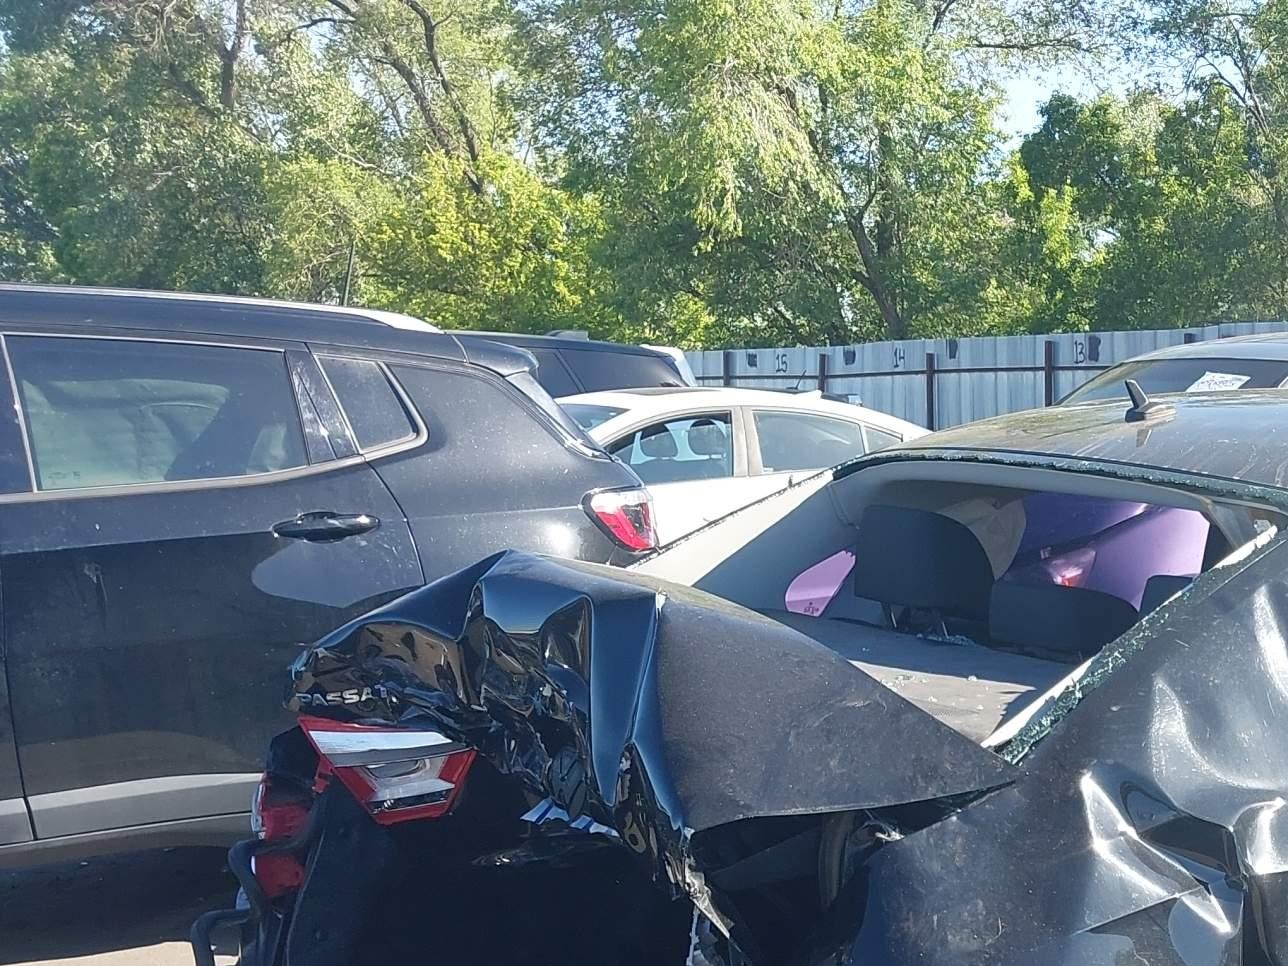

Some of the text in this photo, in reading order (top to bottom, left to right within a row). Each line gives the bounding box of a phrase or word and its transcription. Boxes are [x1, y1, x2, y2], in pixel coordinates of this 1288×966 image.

[894, 347, 906, 369] 14
[1074, 340, 1085, 364] 13
[776, 354, 788, 373] 15
[296, 684, 388, 706] PASSAT
